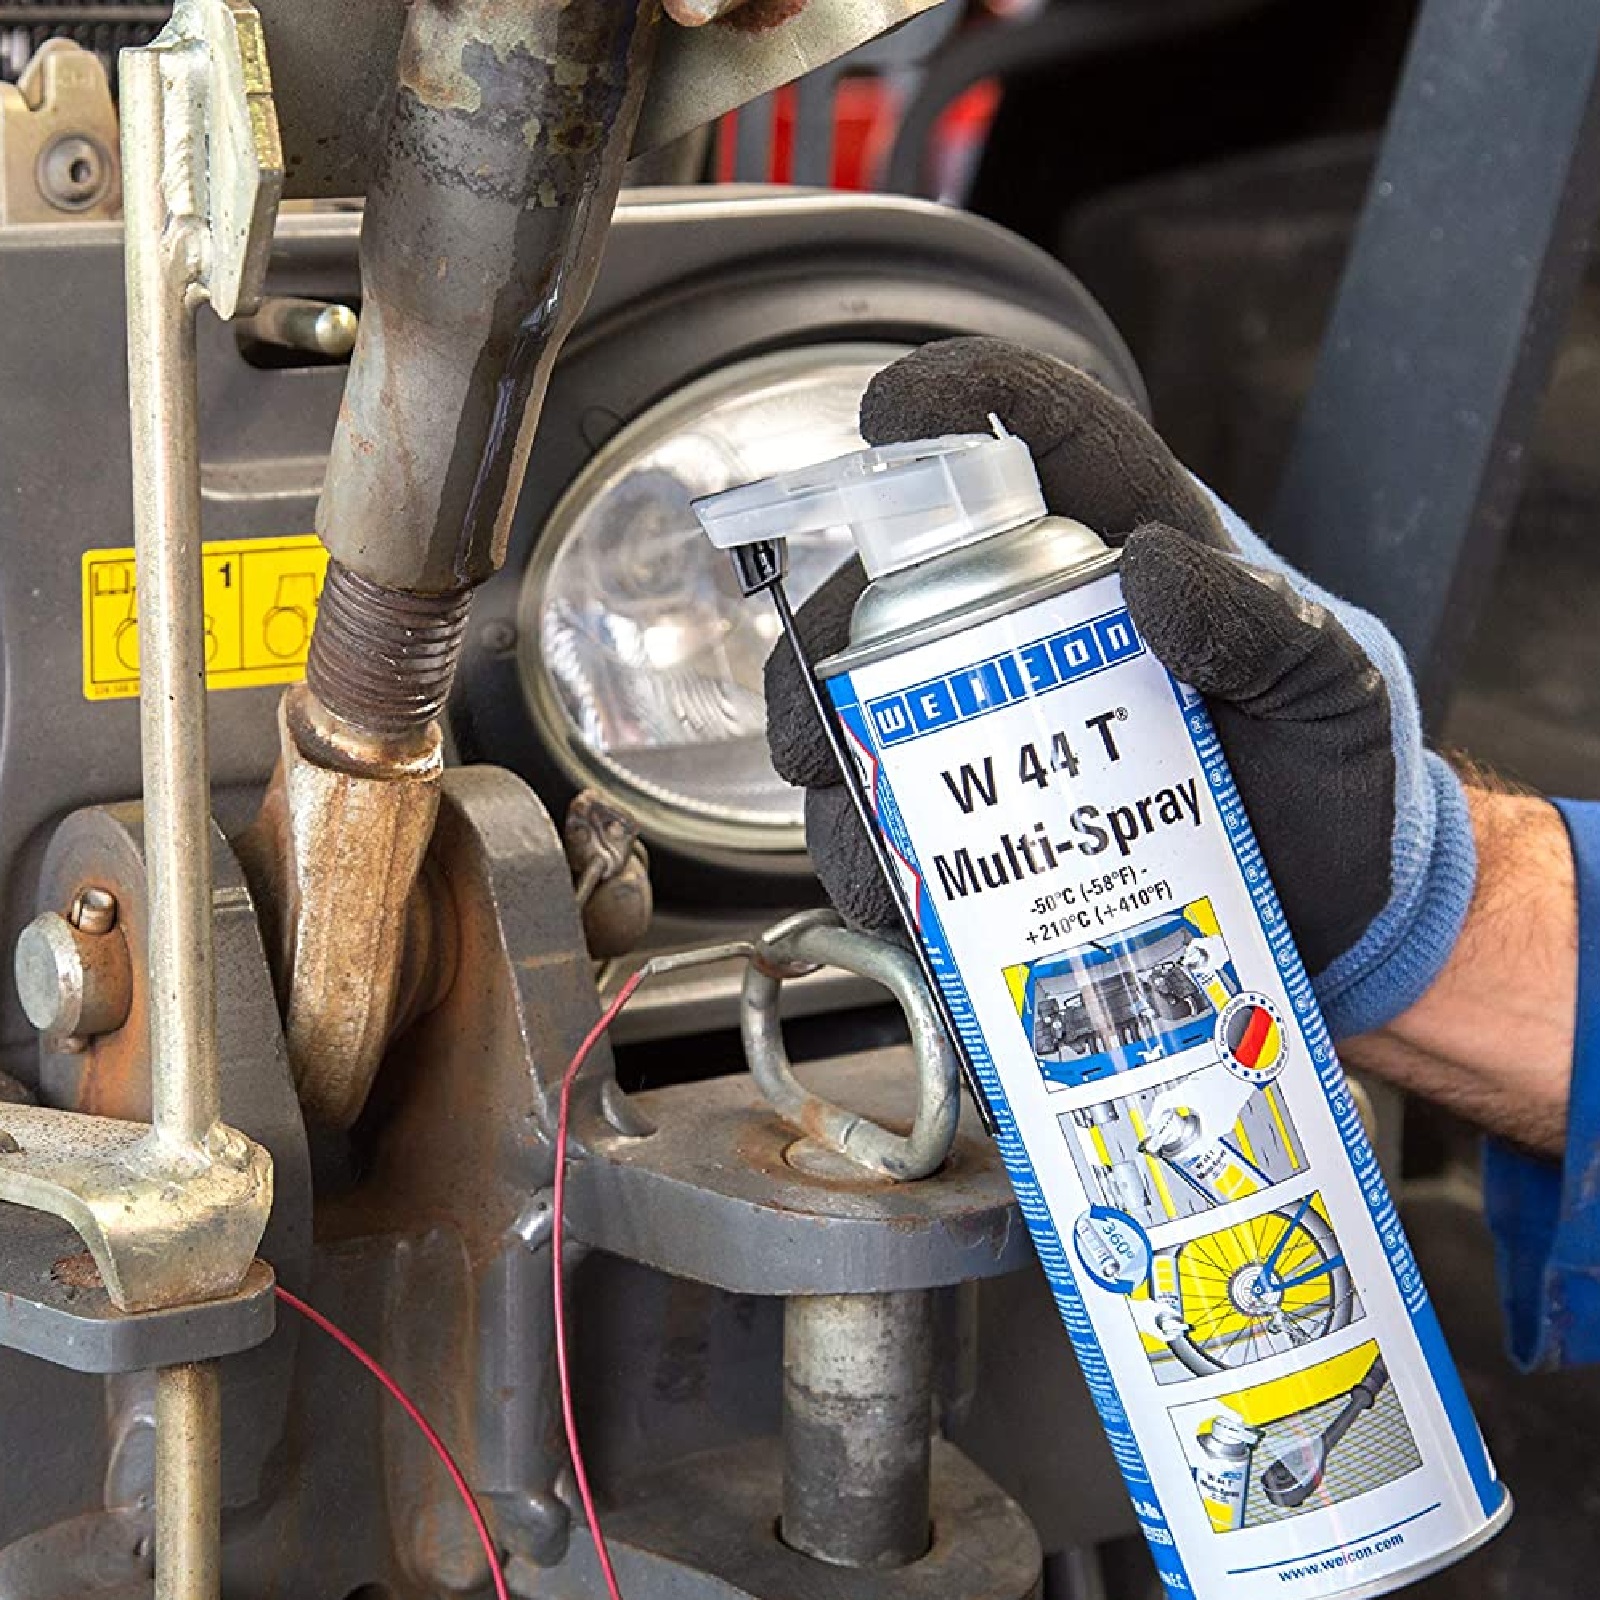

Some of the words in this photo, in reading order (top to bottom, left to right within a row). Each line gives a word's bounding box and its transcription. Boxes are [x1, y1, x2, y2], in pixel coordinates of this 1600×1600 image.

[218, 561, 231, 588] 1
[940, 756, 999, 815] W
[1017, 731, 1081, 790] 44
[933, 776, 1202, 901] Multi-Spray
[1025, 910, 1091, 945] +210°C
[1093, 879, 1173, 925] (+410°F)
[1277, 1533, 1405, 1582] www.weicon.com
